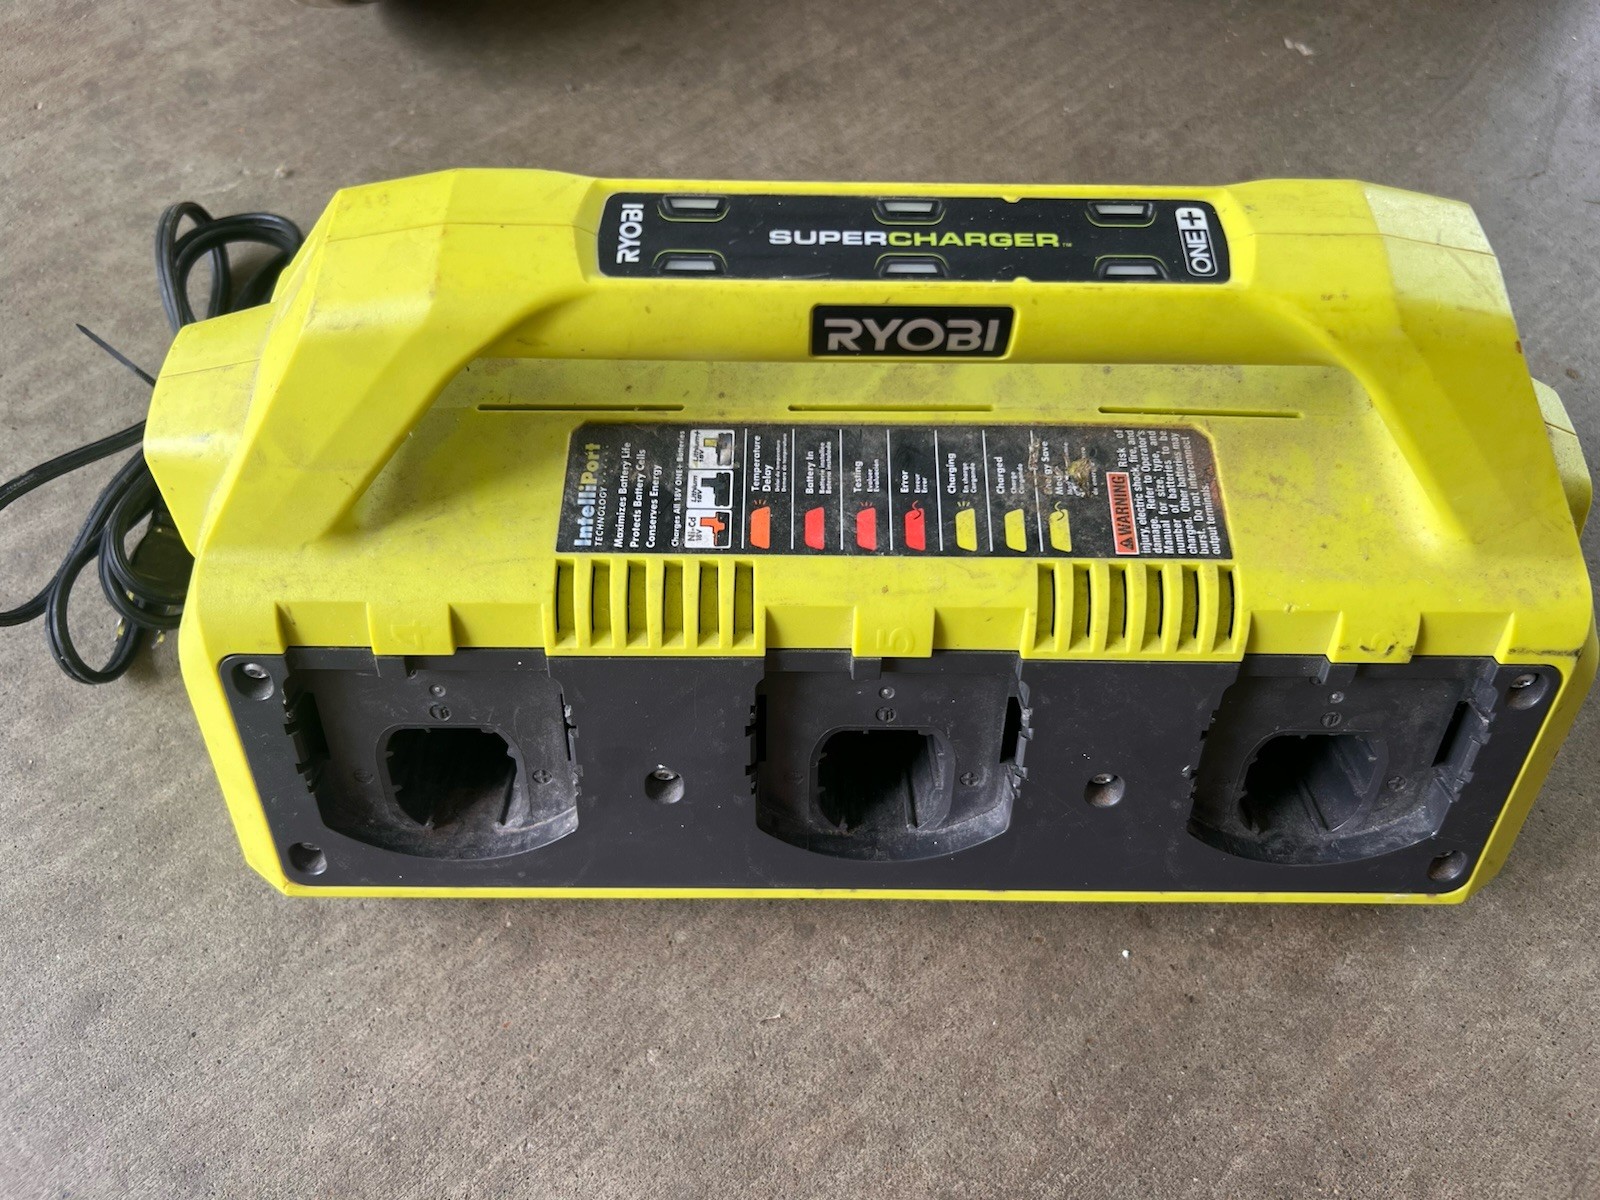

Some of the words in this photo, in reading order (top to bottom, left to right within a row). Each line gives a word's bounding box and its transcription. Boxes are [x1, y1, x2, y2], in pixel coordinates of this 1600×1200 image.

[616, 203, 644, 264] RYOBI
[768, 230, 1060, 247] SUPERCHARGER
[824, 318, 1000, 351] RYOBI
[676, 430, 686, 462] Batteries
[1114, 430, 1124, 438] of
[1125, 430, 1135, 445] and
[1148, 431, 1157, 446] and
[1159, 431, 1168, 441] be
[1171, 432, 1181, 449] may
[621, 442, 631, 458] Life
[637, 449, 646, 470] Cells
[806, 451, 814, 460] In
[1041, 441, 1050, 462] Save
[1118, 447, 1128, 467] Risk
[1129, 447, 1138, 462] fire,
[1137, 430, 1151, 472] Operator's
[1152, 451, 1165, 471] type,
[1162, 446, 1170, 454] to
[1181, 436, 1198, 489] interconnect
[675, 464, 683, 485] ONE+
[751, 435, 761, 492] Temperature
[946, 453, 957, 494] Charging
[994, 456, 1005, 494] Charged
[1173, 452, 1186, 487] batteries
[619, 461, 631, 494] Battery
[633, 473, 646, 507] Battery
[650, 465, 662, 496] Energy
[762, 464, 773, 492] Delay
[806, 462, 815, 494] Battery
[854, 461, 863, 493] Testing
[900, 470, 909, 493] Error
[962, 485, 969, 493] En
[1130, 465, 1143, 491] shock,
[1144, 475, 1152, 483] to
[1164, 460, 1177, 499] batteries
[573, 443, 600, 546] IntelliPort
[674, 487, 682, 501] 18V
[1112, 476, 1132, 535] WARNING
[1146, 487, 1156, 509] Refer
[1180, 490, 1191, 512] Other
[1191, 492, 1200, 506] not
[1201, 483, 1216, 524] terminals.
[595, 486, 607, 546] TECHNOLOGY
[673, 504, 681, 514] All
[1134, 493, 1146, 525] electric
[1158, 502, 1168, 515] for
[1170, 503, 1180, 513] of
[1194, 509, 1204, 521] Do
[614, 497, 627, 548] Maximizes
[630, 510, 642, 548] Protects
[646, 499, 658, 548] Conserves
[671, 516, 682, 547] Charges
[688, 517, 696, 542] Ni-Cd
[1152, 516, 1163, 553] damage.
[1185, 517, 1199, 554] charged.
[1141, 527, 1152, 553] injury,
[1161, 520, 1174, 554] Manual
[1173, 519, 1186, 554] number
[1196, 528, 1209, 554] burst.
[1208, 527, 1221, 554] output
